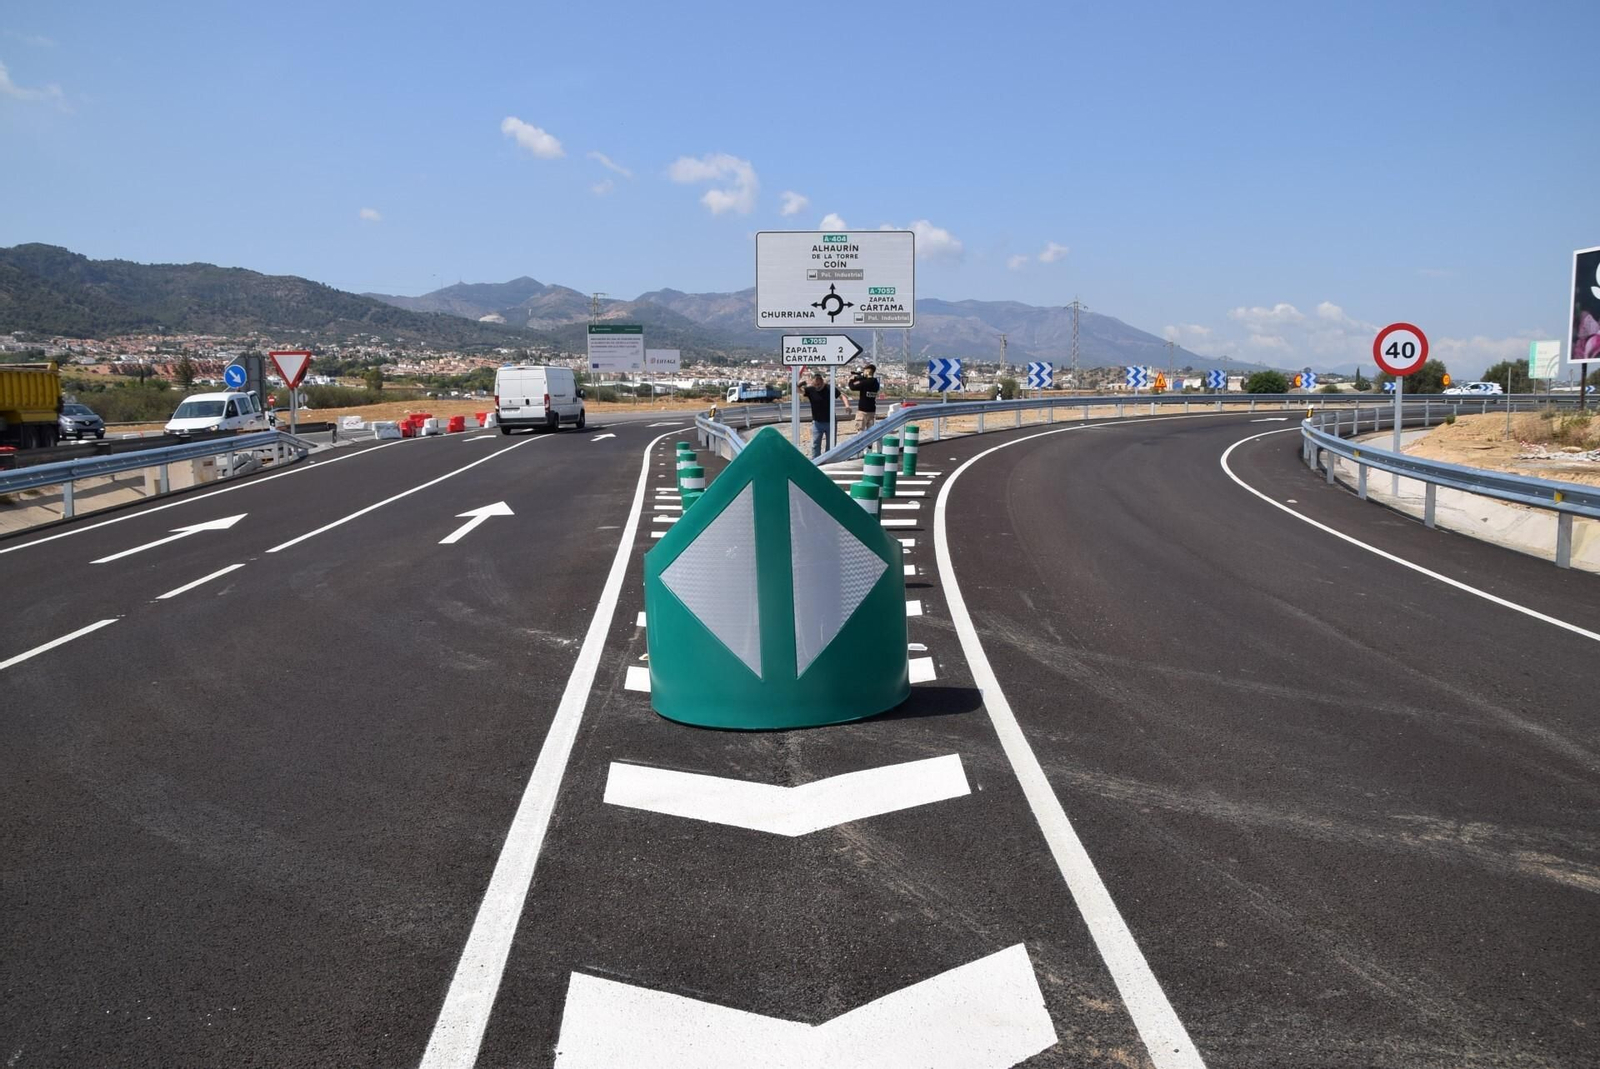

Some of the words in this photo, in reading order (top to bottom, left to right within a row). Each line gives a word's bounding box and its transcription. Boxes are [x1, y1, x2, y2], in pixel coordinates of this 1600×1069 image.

[860, 303, 904, 311] CÁRTAMA
[1385, 342, 1415, 359] 40
[786, 353, 826, 362] CÁRTAMA
